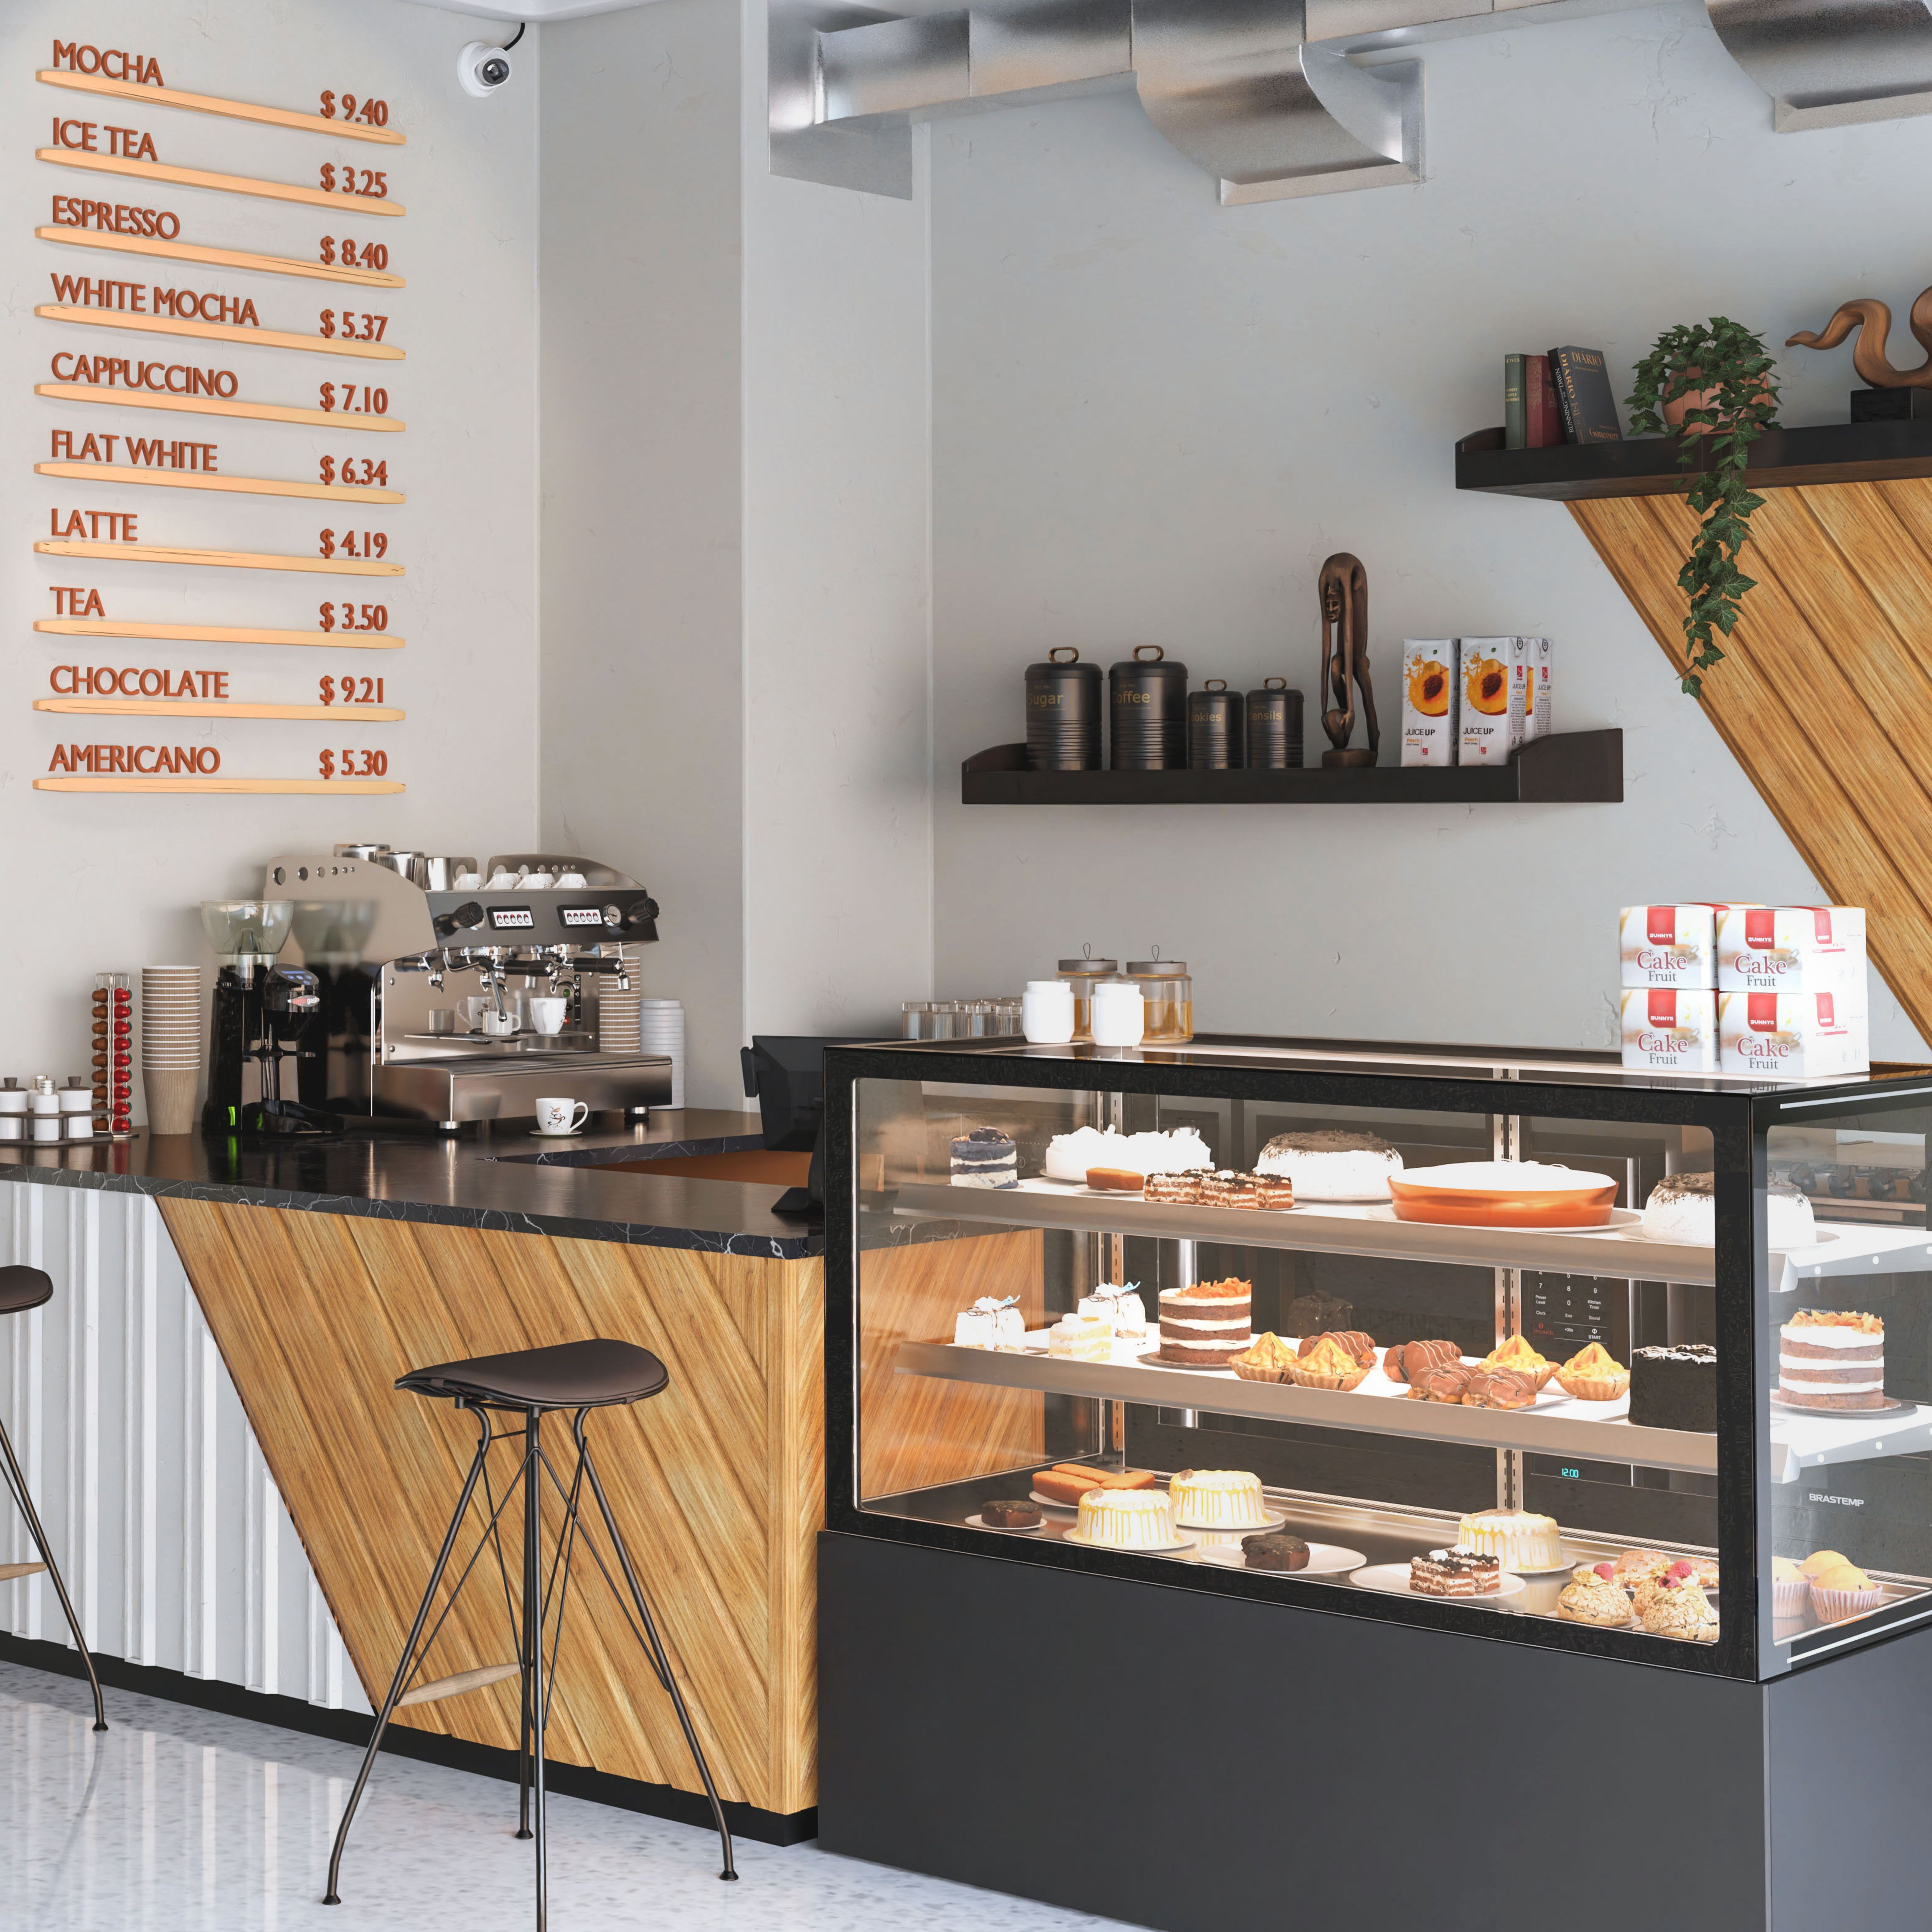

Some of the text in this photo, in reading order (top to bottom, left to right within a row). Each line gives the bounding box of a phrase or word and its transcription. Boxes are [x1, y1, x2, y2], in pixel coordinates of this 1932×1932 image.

[53, 39, 164, 87] MOCHA
[53, 117, 97, 151] ICE
[104, 126, 158, 162] TEA
[52, 195, 180, 240] ESPRESSO
[51, 273, 146, 312] WHITE
[153, 287, 260, 327] MOCHA
[51, 352, 238, 398] CAPPUCCINO
[1554, 368, 1564, 388] DAWN
[1564, 401, 1574, 433] RUNNING
[51, 430, 119, 463] FLAT
[126, 437, 218, 471] WHITE
[51, 508, 138, 542] LATTE
[49, 587, 105, 617] TEA
[50, 665, 229, 698] CHOCOLATE
[48, 744, 221, 774] AMERICANO
[1637, 951, 1687, 969] Cake
[1735, 955, 1787, 975] Cake
[1648, 971, 1677, 982] Fruit
[1747, 975, 1776, 987] Fruit
[1638, 1034, 1688, 1053] Cake
[1737, 1038, 1789, 1057] Cake
[1649, 1053, 1678, 1065] Fruit
[1749, 1058, 1779, 1070] Fruit
[1561, 1467, 1579, 1478] 12:00
[1809, 1493, 1864, 1507] BRASTEMP
